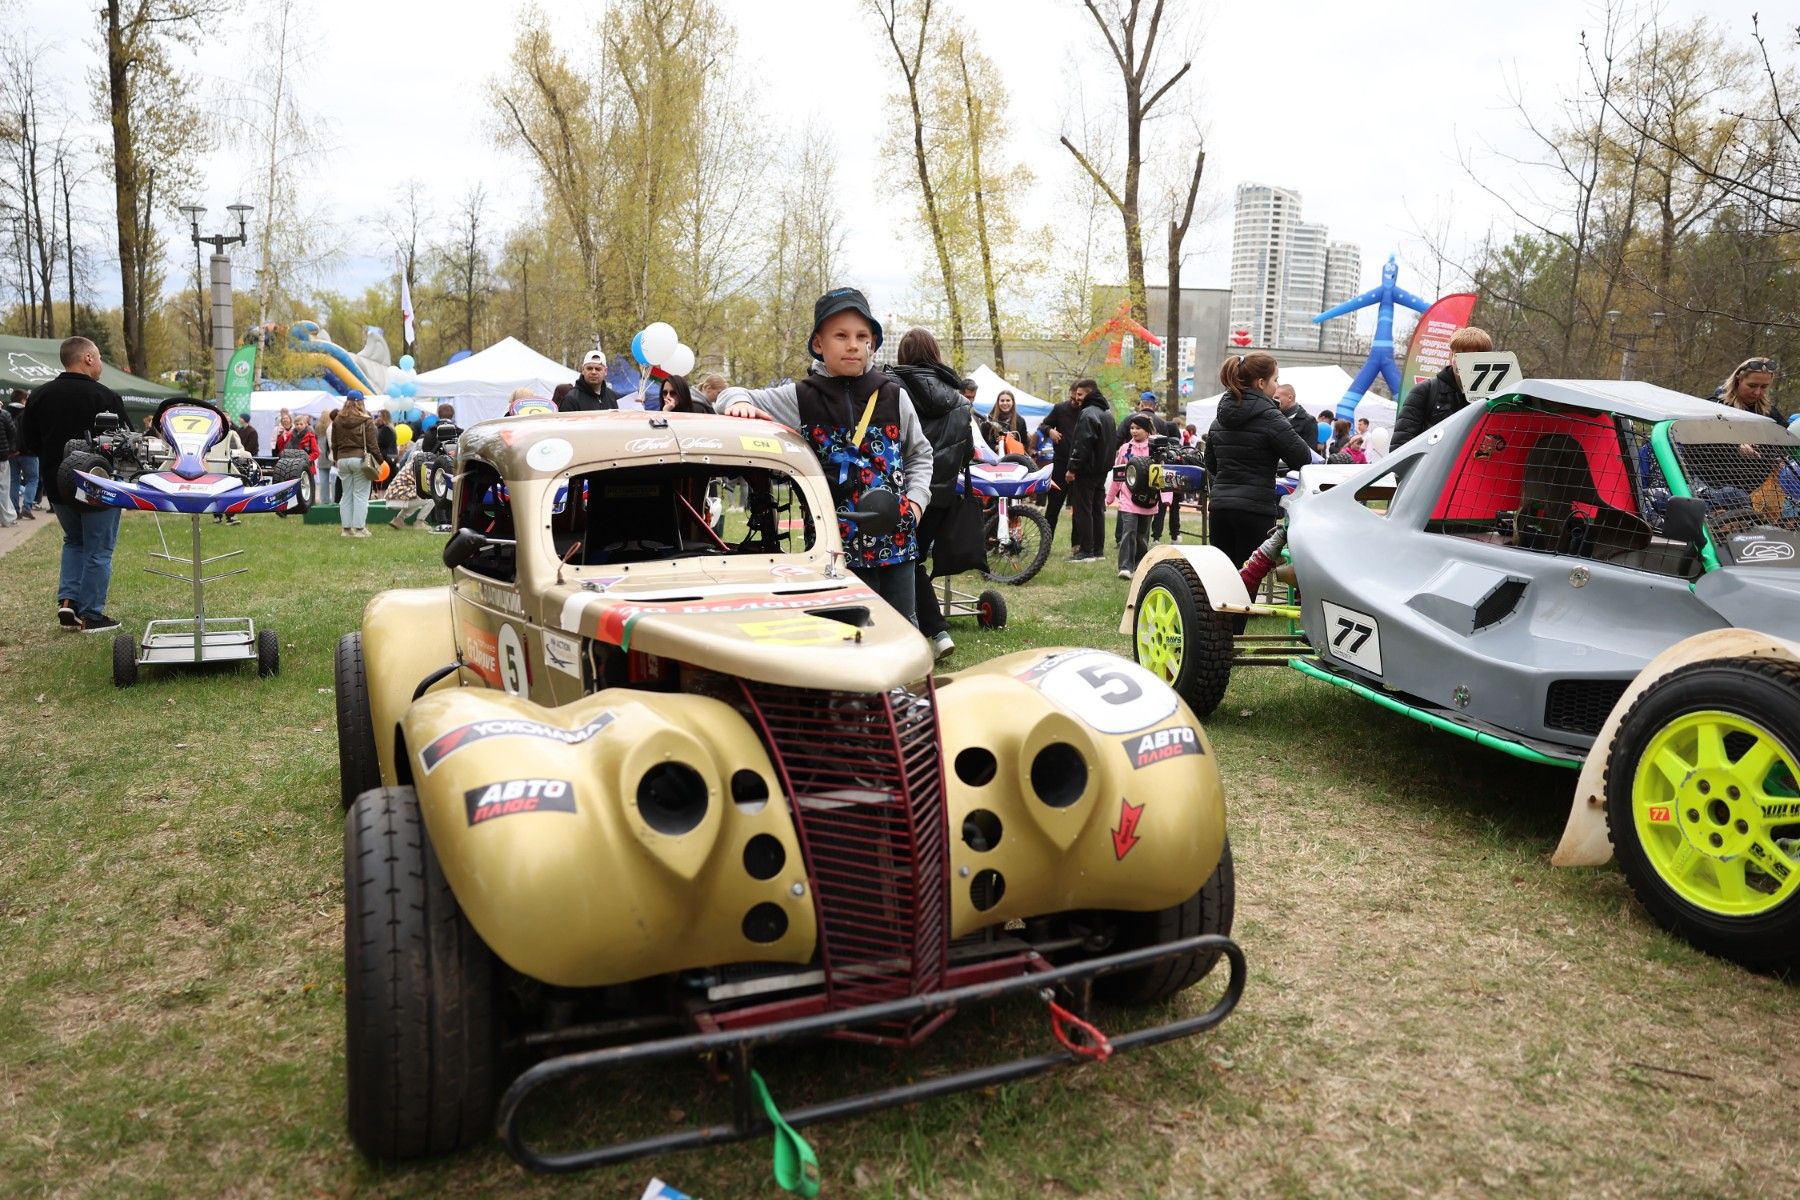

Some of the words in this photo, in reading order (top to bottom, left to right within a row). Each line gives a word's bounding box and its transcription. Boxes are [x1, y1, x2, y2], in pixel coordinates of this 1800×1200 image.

[1470, 363, 1511, 392] 77
[182, 418, 201, 430] 7
[752, 440, 771, 448] CN
[1151, 466, 1160, 487] 2
[1332, 617, 1374, 654] 77
[506, 644, 520, 692] 5
[1076, 662, 1144, 706] 5
[472, 720, 605, 744] YOKOHAMA
[1137, 727, 1195, 755] АВТО
[477, 779, 567, 806] АВТО
[1651, 807, 1668, 820] 77
